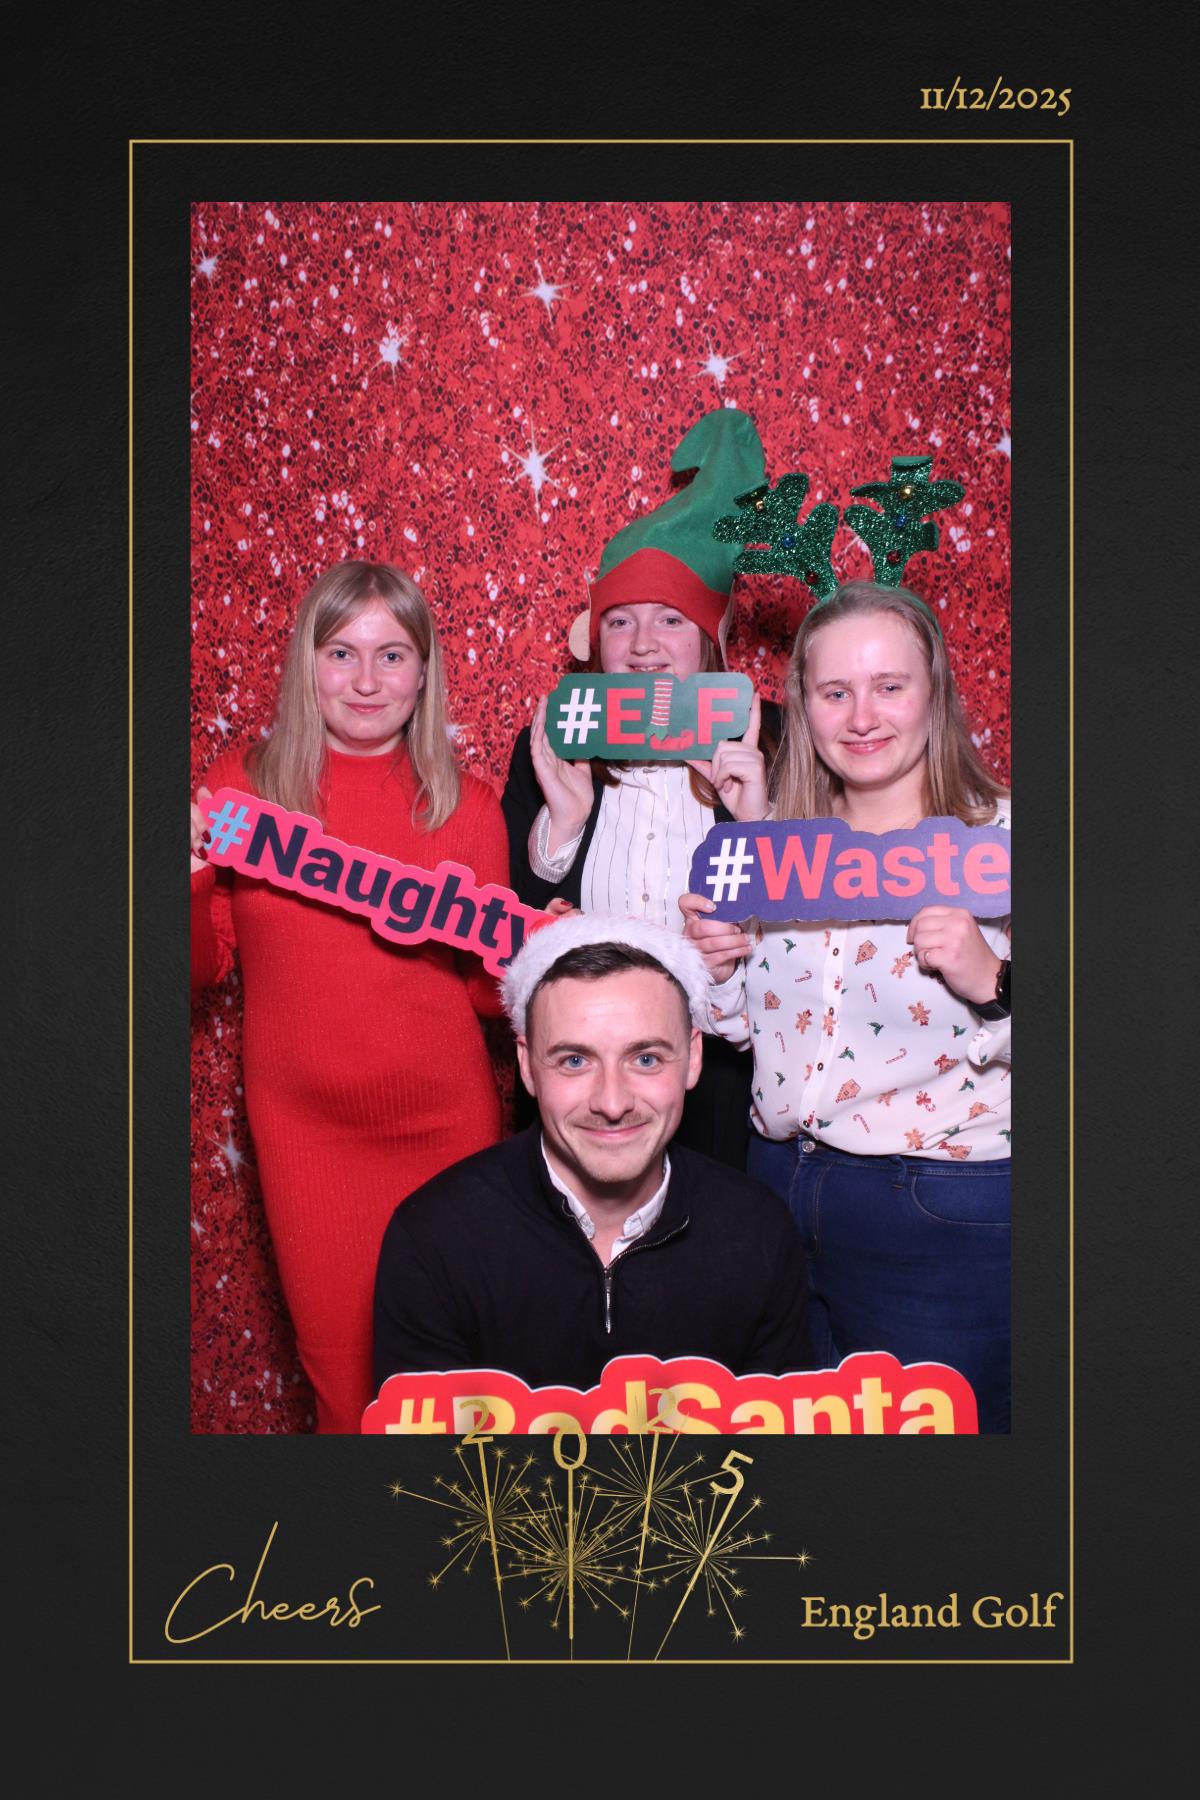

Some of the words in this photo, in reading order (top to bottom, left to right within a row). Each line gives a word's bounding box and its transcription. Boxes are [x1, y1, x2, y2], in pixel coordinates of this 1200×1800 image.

[556, 678, 739, 751] #ELF
[203, 800, 526, 969] #Naughty
[705, 832, 1010, 902] #Waste
